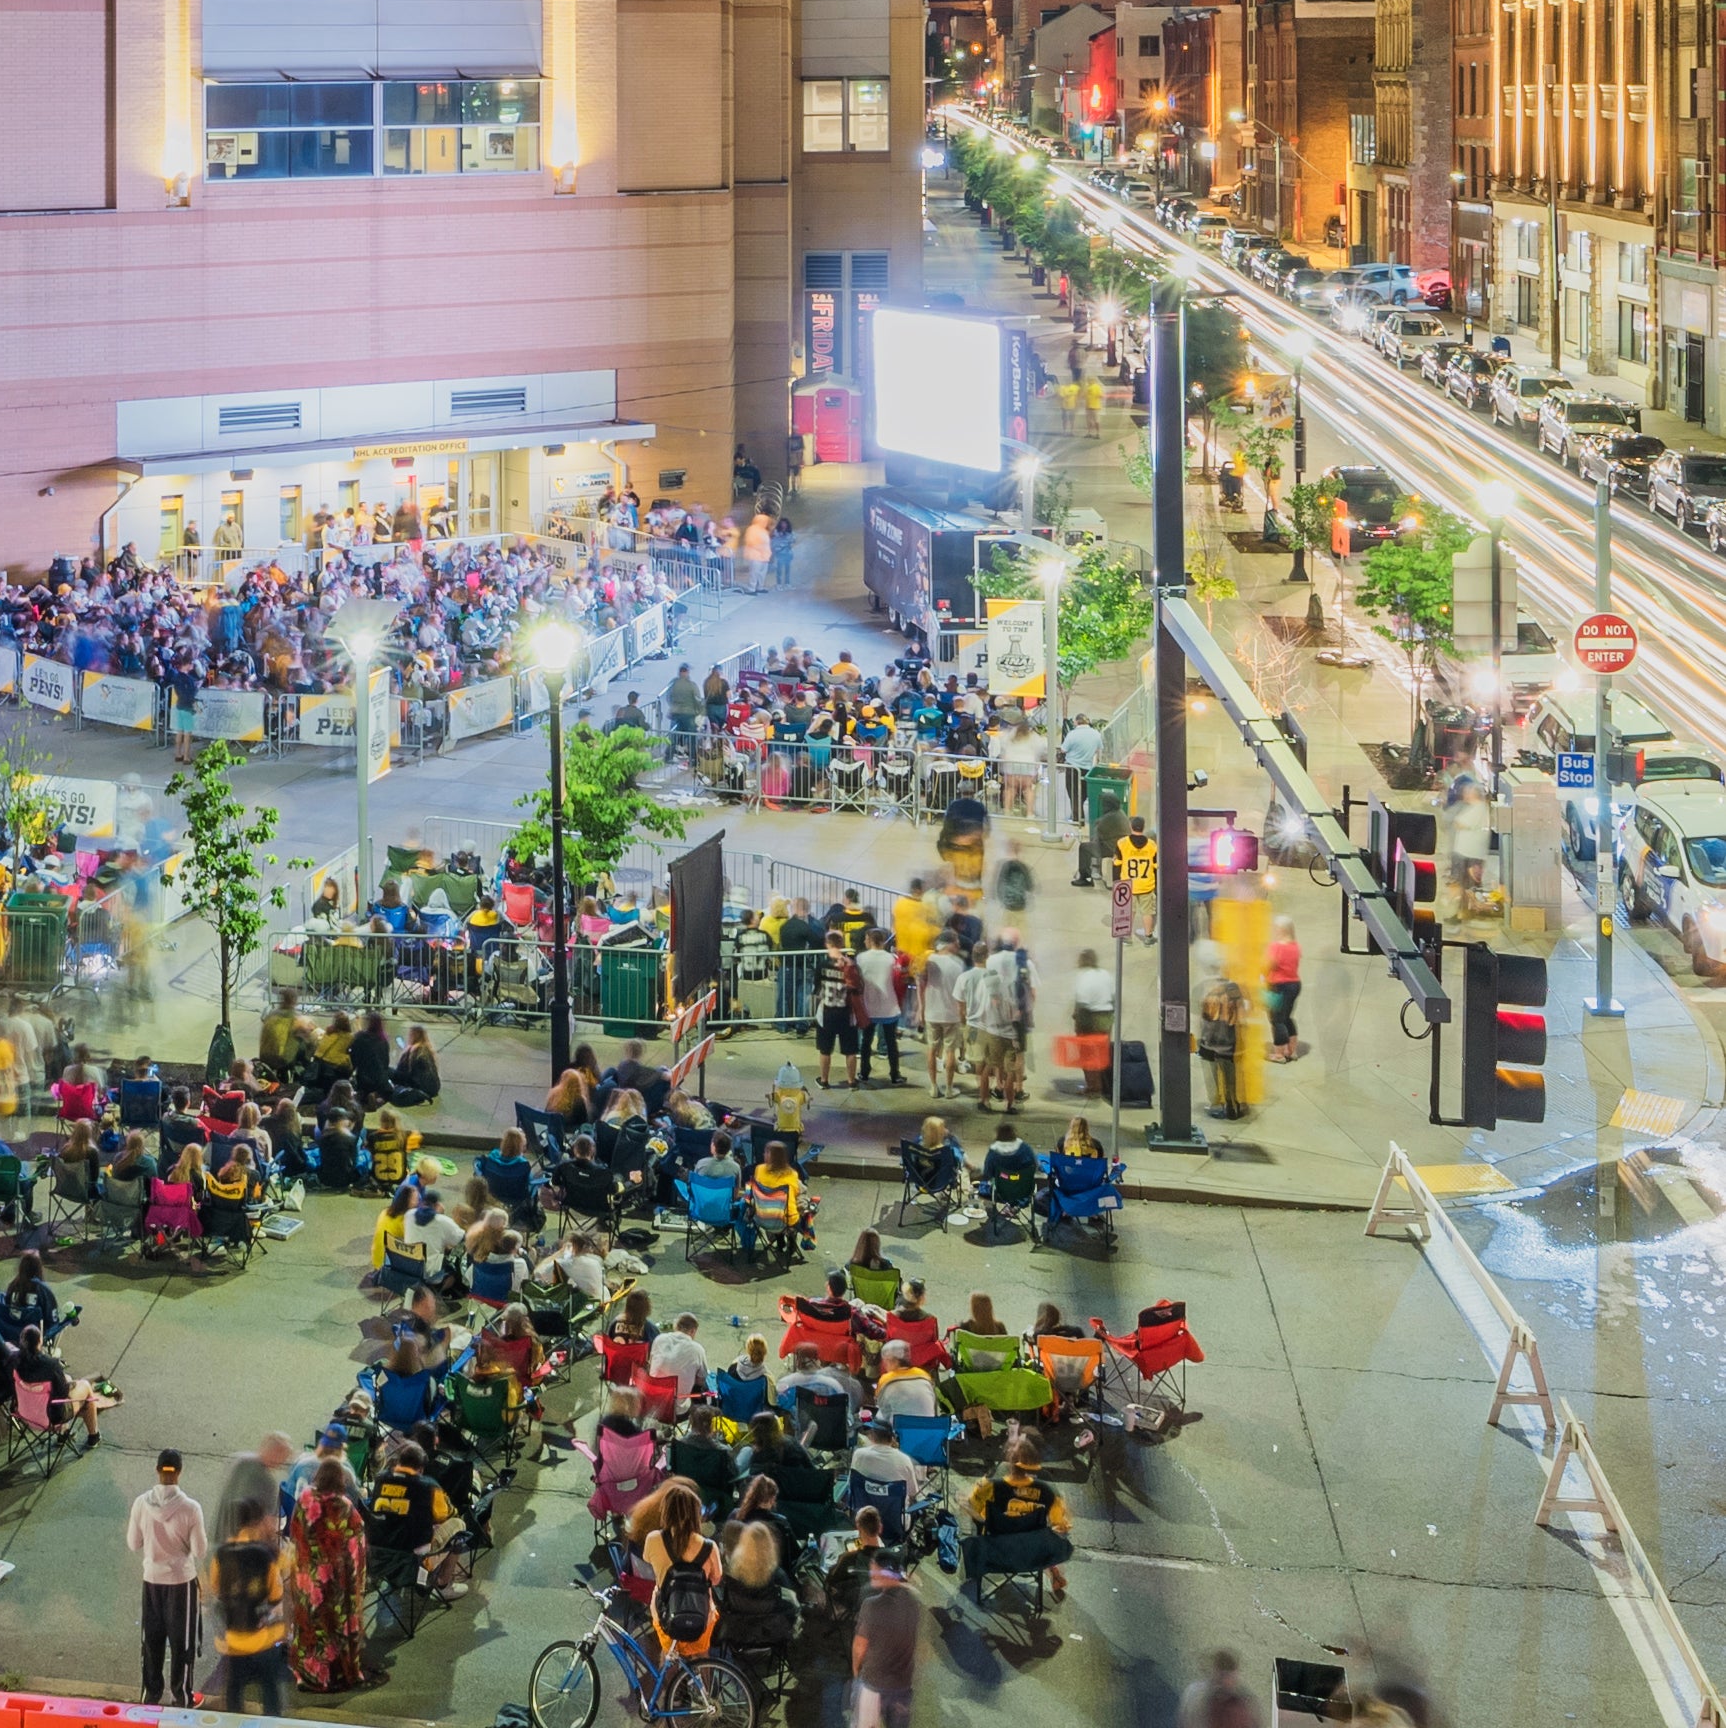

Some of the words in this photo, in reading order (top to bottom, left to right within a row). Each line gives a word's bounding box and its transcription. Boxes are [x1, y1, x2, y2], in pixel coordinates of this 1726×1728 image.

[1010, 334, 1023, 413] KeyBank
[353, 449, 370, 458] NHL
[372, 443, 437, 458] ACCREDITATION
[438, 441, 467, 452] OFFICE
[1582, 624, 1599, 636] DO
[1605, 624, 1629, 636] NOT
[1587, 651, 1625, 663] ENTER
[28, 676, 64, 702] PENS!
[1562, 756, 1590, 769] Bus
[1559, 770, 1594, 786] Stop
[70, 790, 86, 804] GO
[46, 803, 96, 826] ENS!
[1126, 858, 1151, 879] 87
